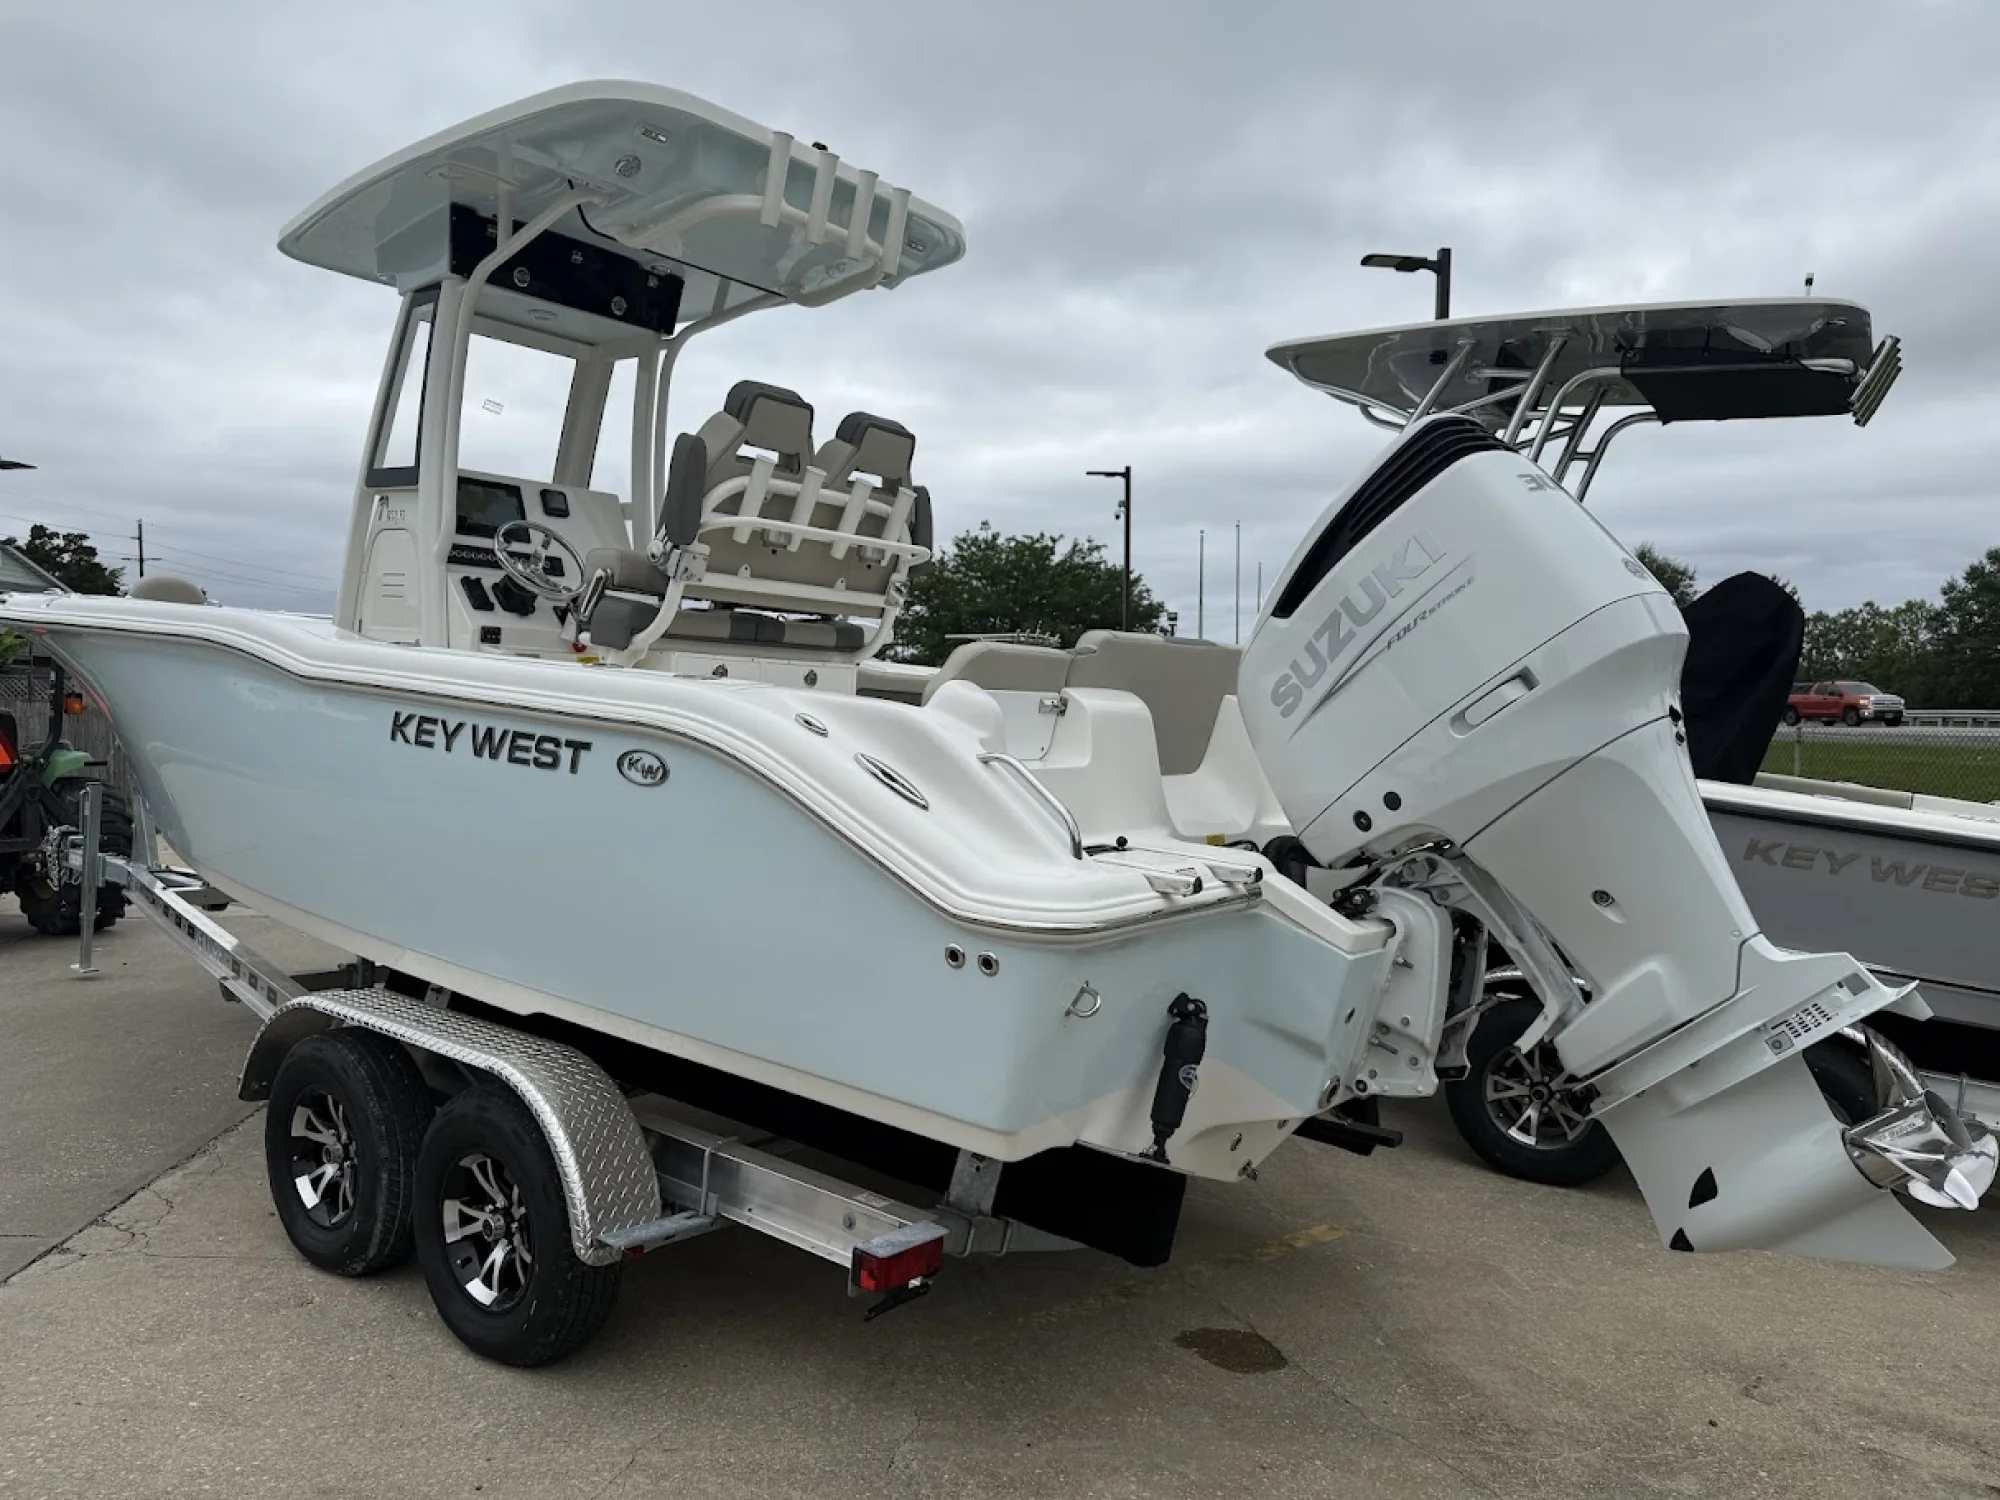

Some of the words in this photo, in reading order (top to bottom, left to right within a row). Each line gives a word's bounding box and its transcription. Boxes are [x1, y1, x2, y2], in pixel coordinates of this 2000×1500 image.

[1271, 527, 1447, 719] SUZUKI
[1386, 610, 1428, 651] FOUR
[389, 710, 467, 753] KEY
[471, 723, 593, 775] WEST
[625, 754, 664, 782] KW
[1743, 838, 1863, 876] KEY
[1870, 855, 2000, 900] WES
